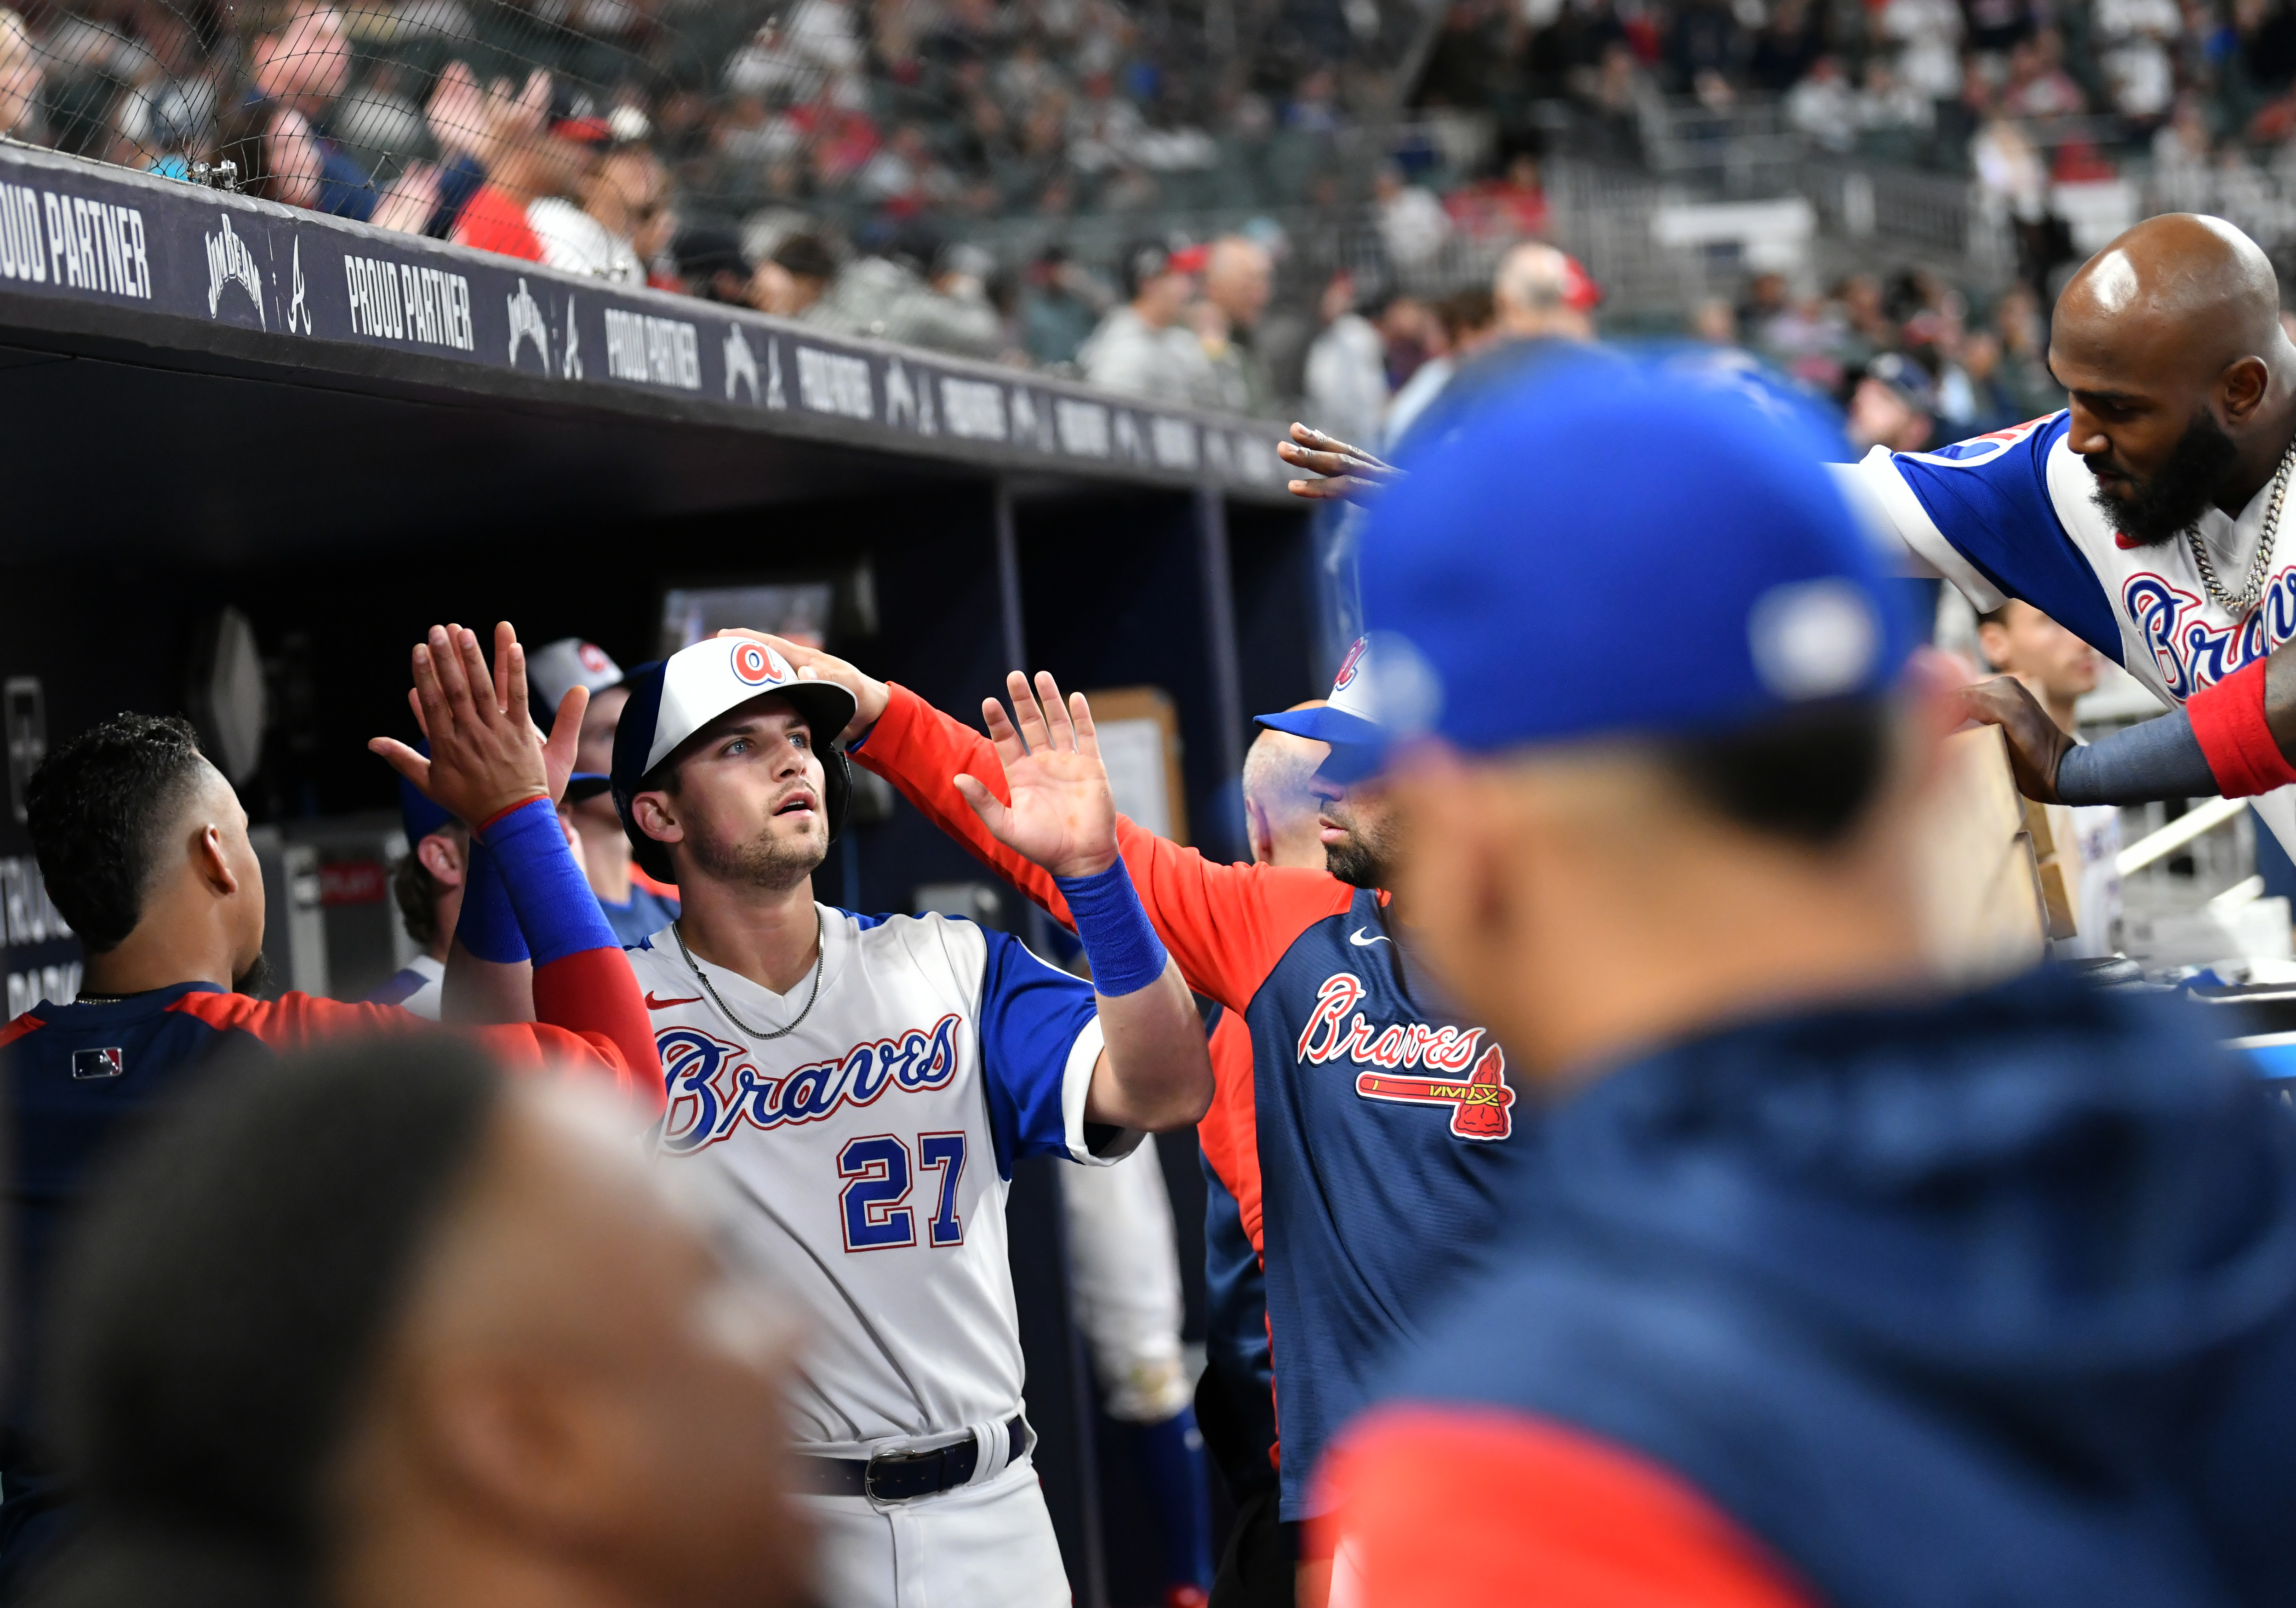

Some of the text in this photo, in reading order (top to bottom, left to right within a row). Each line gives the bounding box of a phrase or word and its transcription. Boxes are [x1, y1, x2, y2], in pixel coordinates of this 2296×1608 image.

[0, 181, 151, 299] OUD PARTNER
[205, 213, 266, 333] JIM BEAM
[344, 254, 403, 339] PROUD
[400, 264, 474, 351] PARTNER
[2122, 565, 2296, 704] Brav
[1298, 973, 1486, 1072] Braves
[655, 1013, 961, 1157] Braves
[837, 1131, 967, 1253] 27
